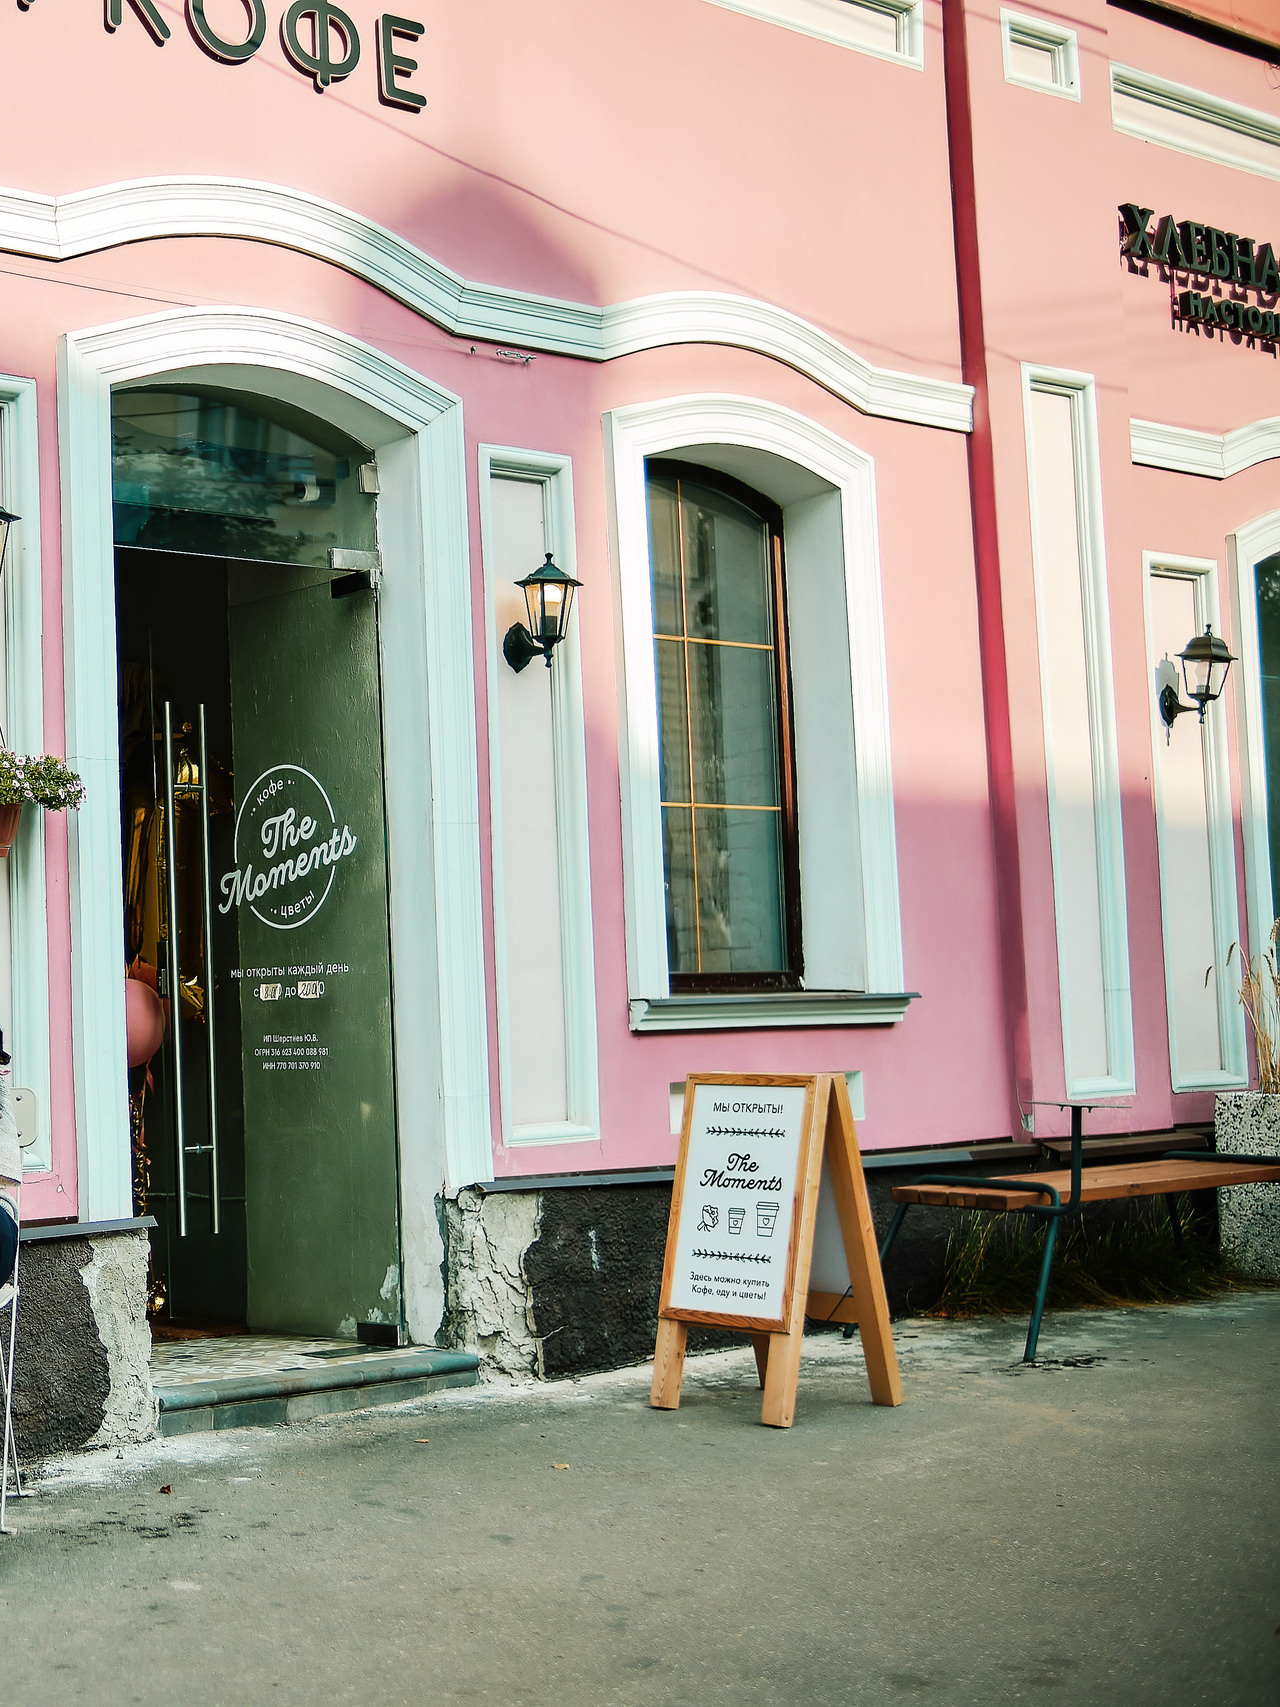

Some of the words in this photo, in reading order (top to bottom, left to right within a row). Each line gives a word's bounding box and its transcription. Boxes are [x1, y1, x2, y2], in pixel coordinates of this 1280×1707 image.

[1179, 290, 1280, 340] НАСТОЯ
[256, 778, 284, 806] кофе
[261, 807, 318, 859] The
[218, 824, 358, 914] Moments
[280, 890, 316, 919] цветы
[230, 968, 244, 979] мы
[246, 965, 285, 980] открыты
[287, 961, 324, 978] каждый
[326, 962, 349, 977] день
[253, 987, 260, 998] с
[284, 986, 297, 999] до
[263, 1034, 272, 1043] ИП
[254, 1048, 270, 1057] ОГРН
[271, 1048, 281, 1057] 316
[293, 1047, 305, 1056] 400
[262, 1062, 276, 1070] ИНН
[276, 1062, 287, 1070] 770
[287, 1062, 298, 1070] 701
[310, 1061, 321, 1070] 910
[713, 1102, 730, 1113] МЫ
[732, 1102, 784, 1114] ОТКРЫТЫ!
[726, 1152, 759, 1173] The
[699, 1168, 783, 1192] Moments
[689, 1270, 712, 1282] Здесь
[713, 1275, 741, 1285] можно
[742, 1279, 770, 1288] купить
[691, 1284, 714, 1296] Кофе,
[716, 1288, 731, 1299] еду
[739, 1291, 767, 1301] цветы!
